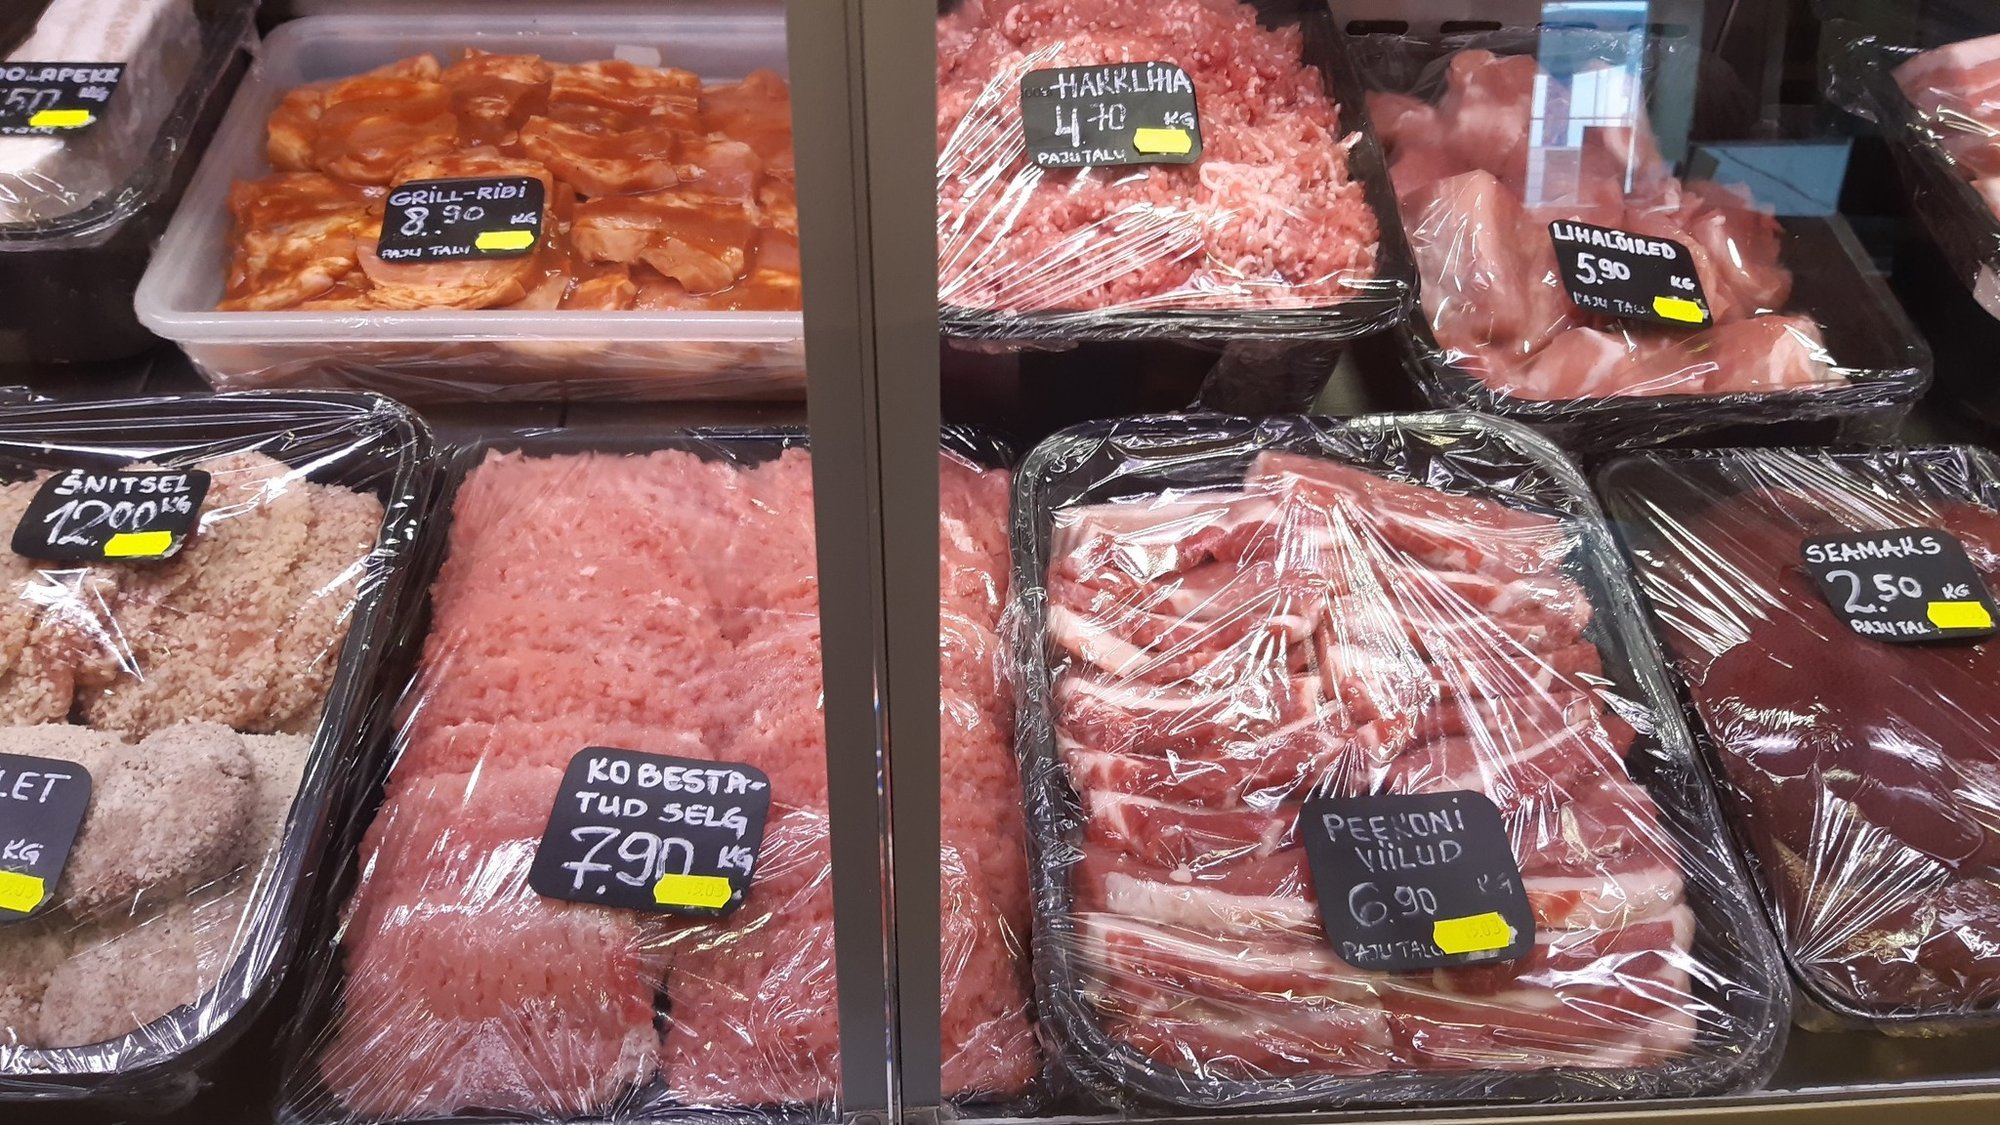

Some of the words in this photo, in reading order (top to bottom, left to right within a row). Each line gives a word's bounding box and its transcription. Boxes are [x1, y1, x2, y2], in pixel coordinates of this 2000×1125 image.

[1049, 62, 1192, 99] HAKKLIHA
[1553, 222, 1677, 260] LIHALÕIRED
[1575, 252, 1631, 285] 5.90
[1670, 275, 1696, 291] KG
[1805, 536, 1942, 563] SEAMAKS
[1825, 569, 1923, 614] 2.50
[1942, 582, 1971, 600] KG
[575, 791, 649, 817] TUD
[658, 803, 748, 840] SELG
[1322, 797, 1465, 842] PEEKONI
[2, 838, 44, 866] KG
[717, 844, 753, 876] KG
[1348, 882, 1438, 928] 6.90
